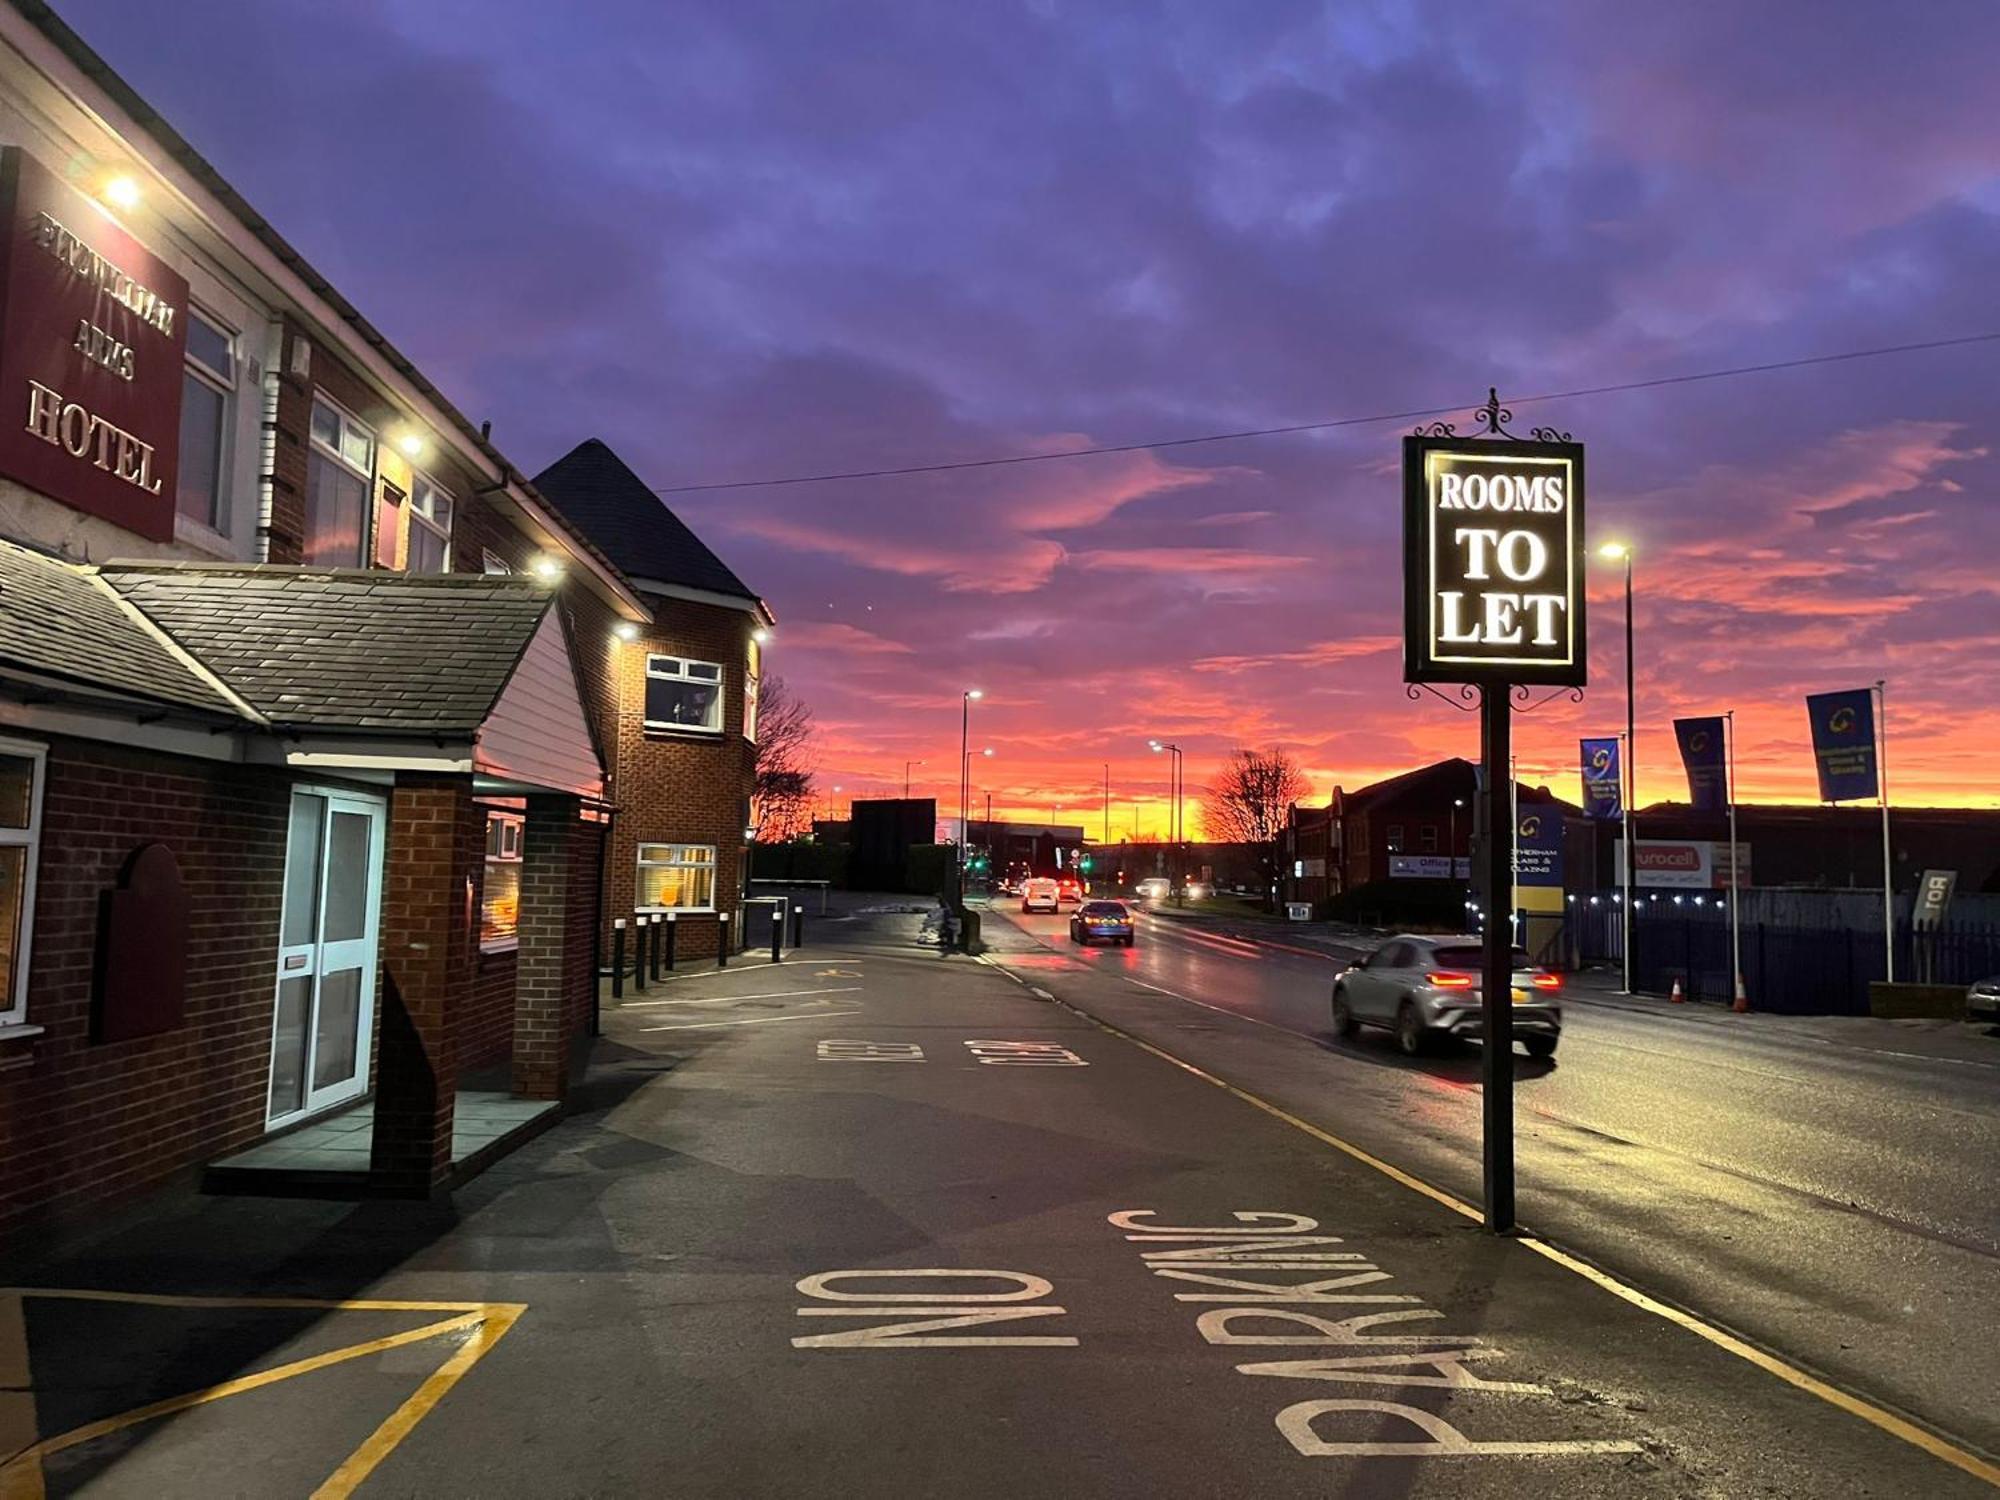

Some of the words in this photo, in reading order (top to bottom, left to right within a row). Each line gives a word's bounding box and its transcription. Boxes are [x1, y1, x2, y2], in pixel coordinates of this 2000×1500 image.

[74, 318, 136, 382] ARMS
[25, 380, 163, 496] HOTEL
[1439, 473, 1564, 513] ROOMS
[1455, 528, 1547, 582] TO
[1437, 592, 1566, 645] LET
[1635, 850, 1694, 865] urocell
[790, 1268, 1081, 1349] NO
[1106, 1209, 1647, 1457] PARKING
